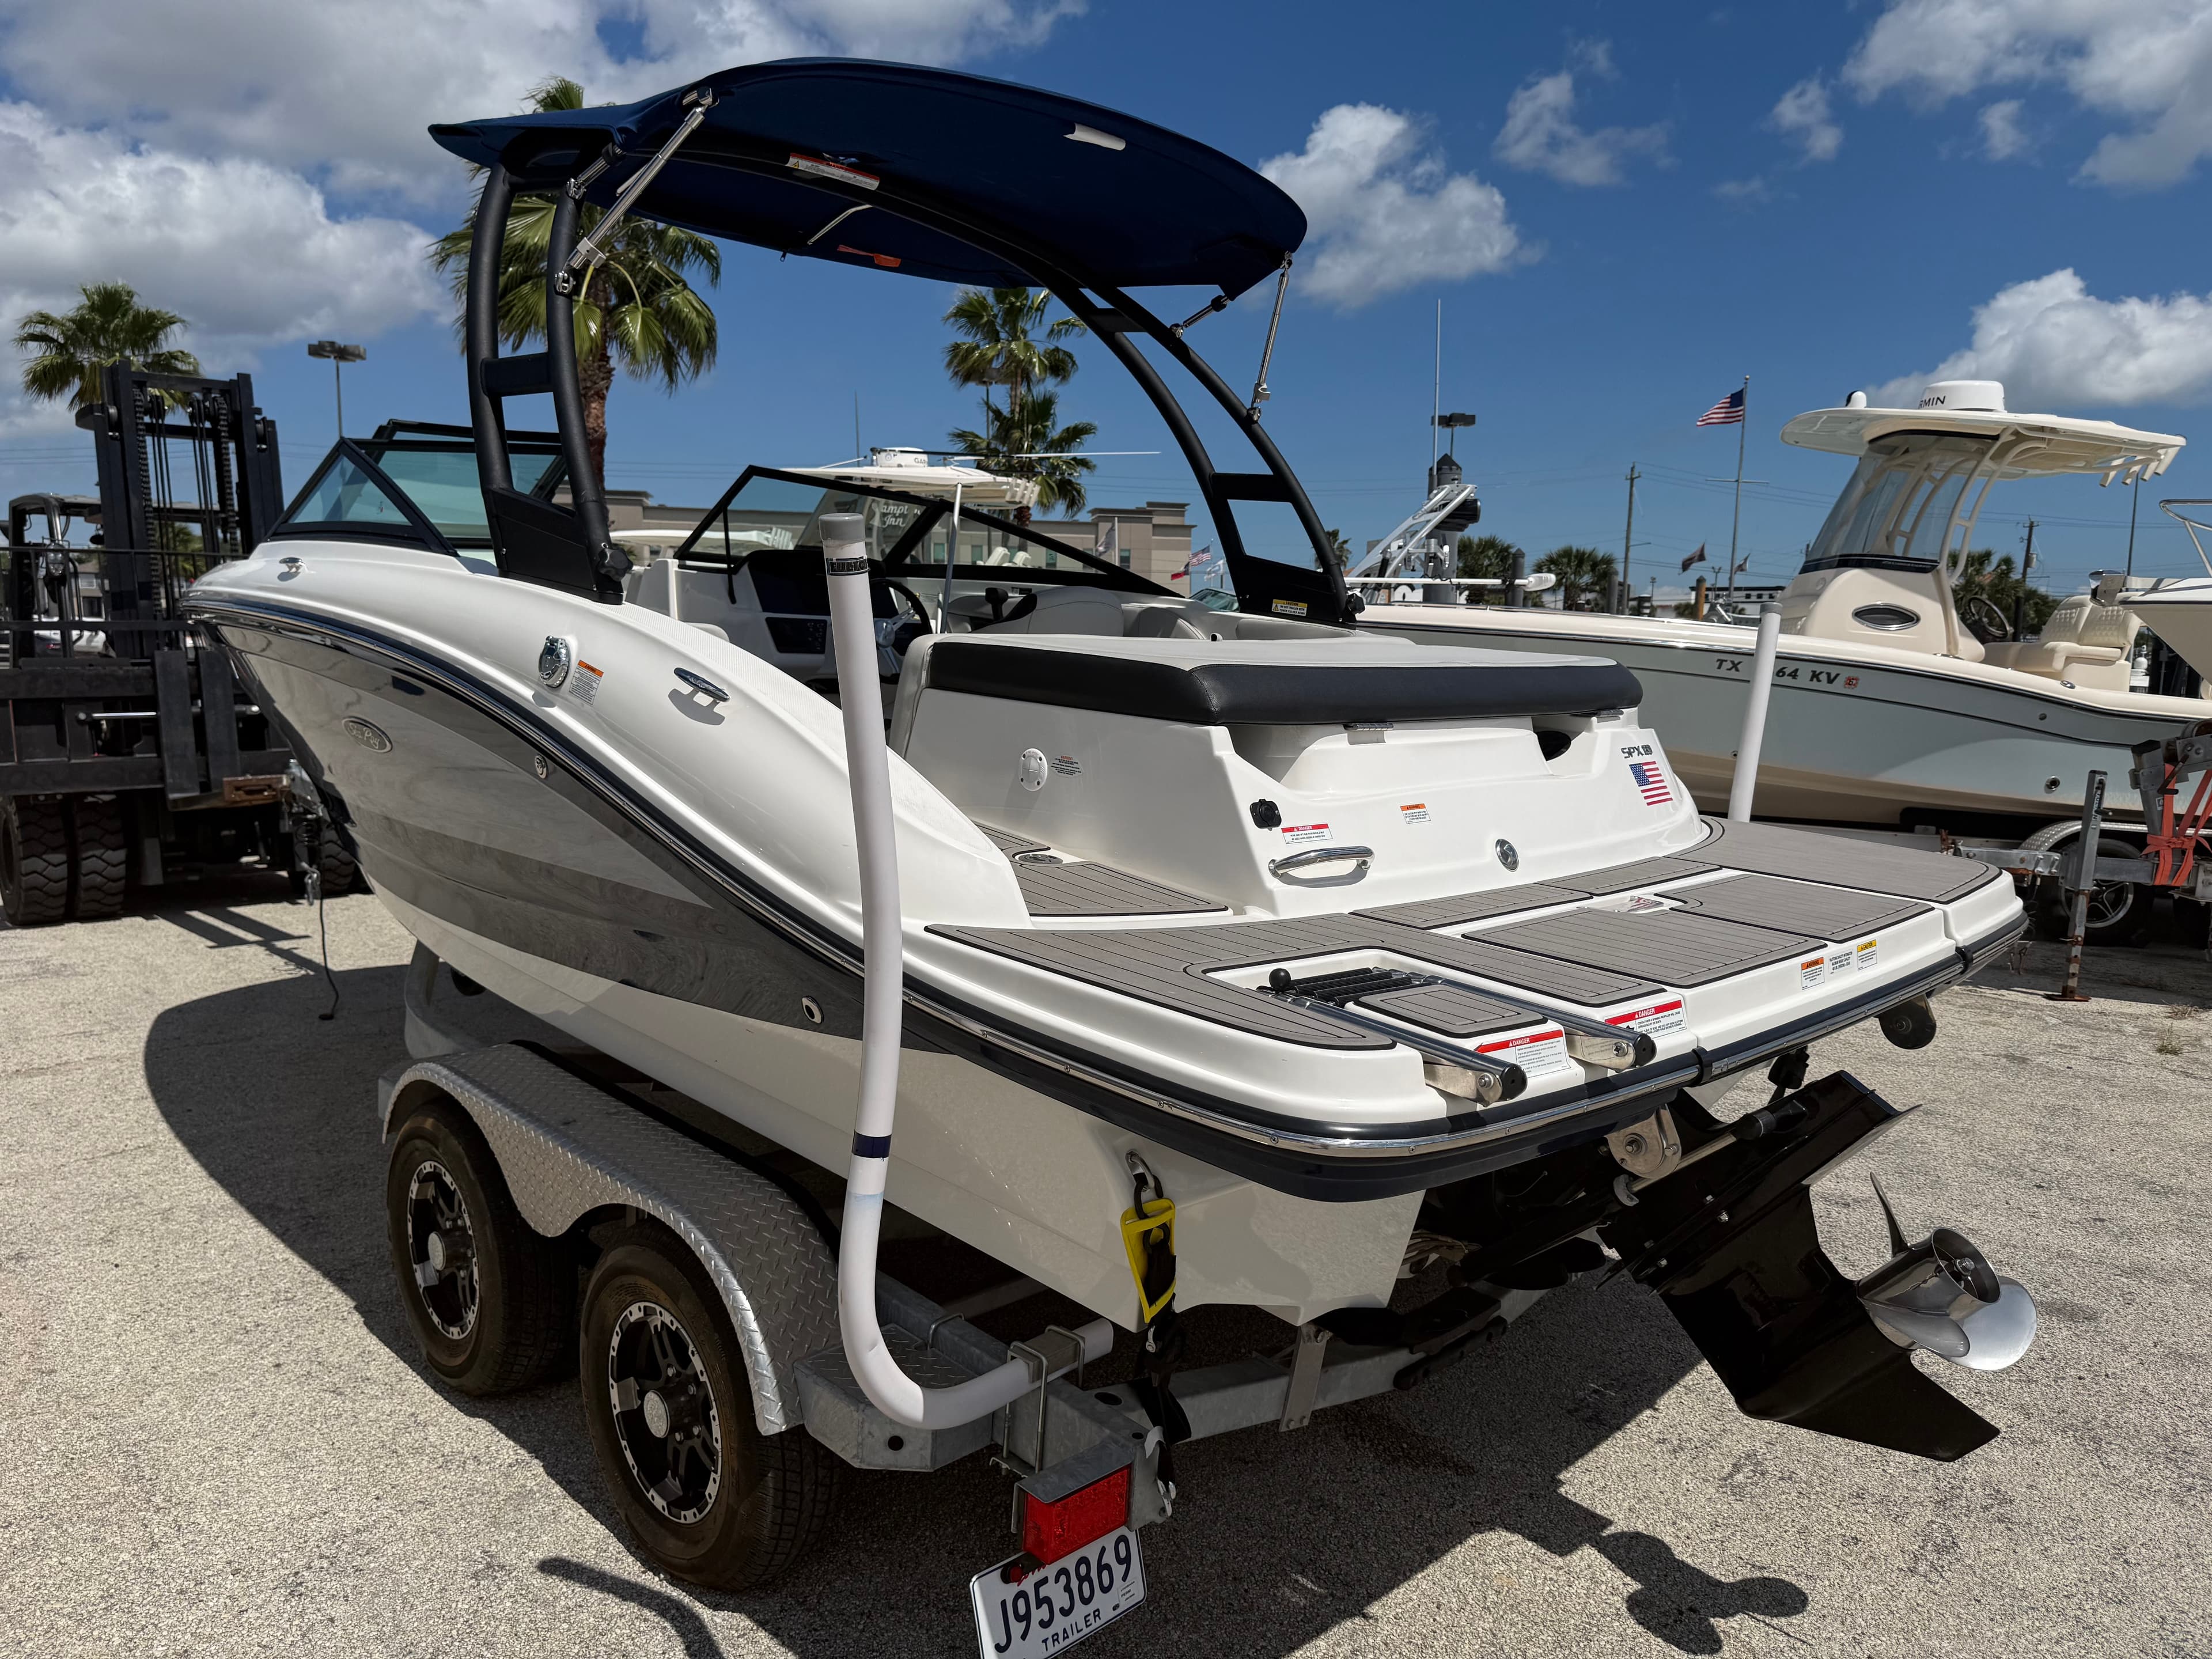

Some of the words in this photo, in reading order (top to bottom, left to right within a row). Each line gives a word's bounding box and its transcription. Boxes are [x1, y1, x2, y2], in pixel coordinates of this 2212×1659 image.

[1918, 395, 1946, 409] RMIN
[882, 514, 906, 528] Inn
[1715, 658, 1743, 672] TX
[1775, 666, 1800, 680] 64
[1809, 670, 1840, 684] KV
[1620, 745, 1645, 759] SPX
[1638, 1008, 1656, 1018] DANGER
[1513, 1037, 1531, 1046] DANGER
[994, 1535, 1131, 1653] J953869
[1041, 1608, 1101, 1652] TRAILER
